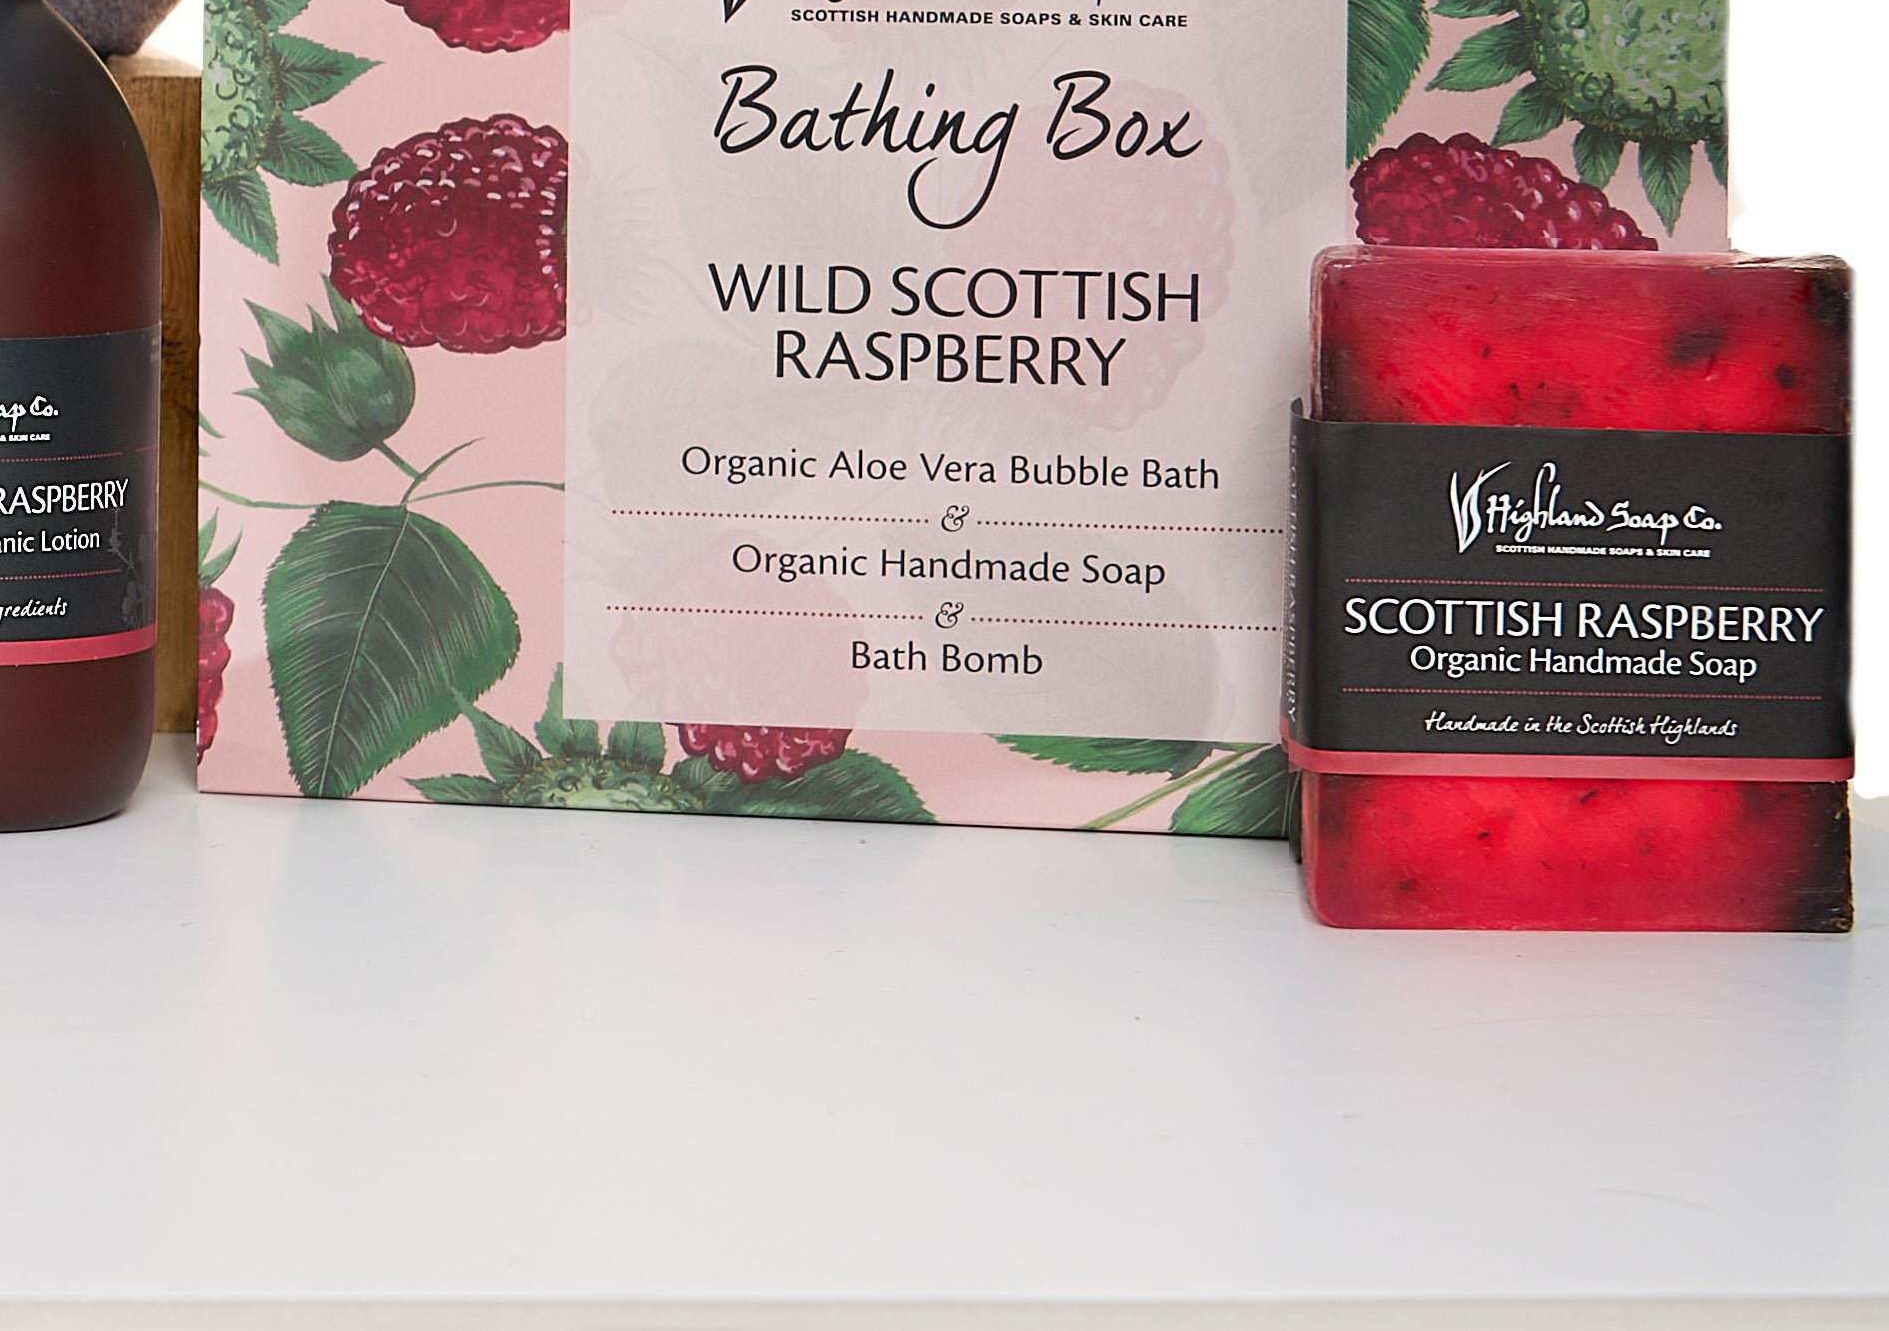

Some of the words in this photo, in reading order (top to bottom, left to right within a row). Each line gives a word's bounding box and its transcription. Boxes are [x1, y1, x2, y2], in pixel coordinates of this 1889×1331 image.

[713, 64, 1020, 230] Bathing
[1046, 70, 1203, 161] Box
[41, 528, 100, 552] Lotion
[732, 544, 868, 583] Organic
[881, 548, 1070, 583] Handmade
[1082, 554, 1166, 594] Soap
[1344, 597, 1562, 637] SCOTTISH
[1578, 602, 1824, 642] RASPBERRY
[852, 640, 927, 671] Bath
[942, 643, 1043, 675] Bomb
[1410, 645, 1522, 679] Organic
[1529, 647, 1682, 675] Handmade
[1689, 651, 1757, 684] Soap
